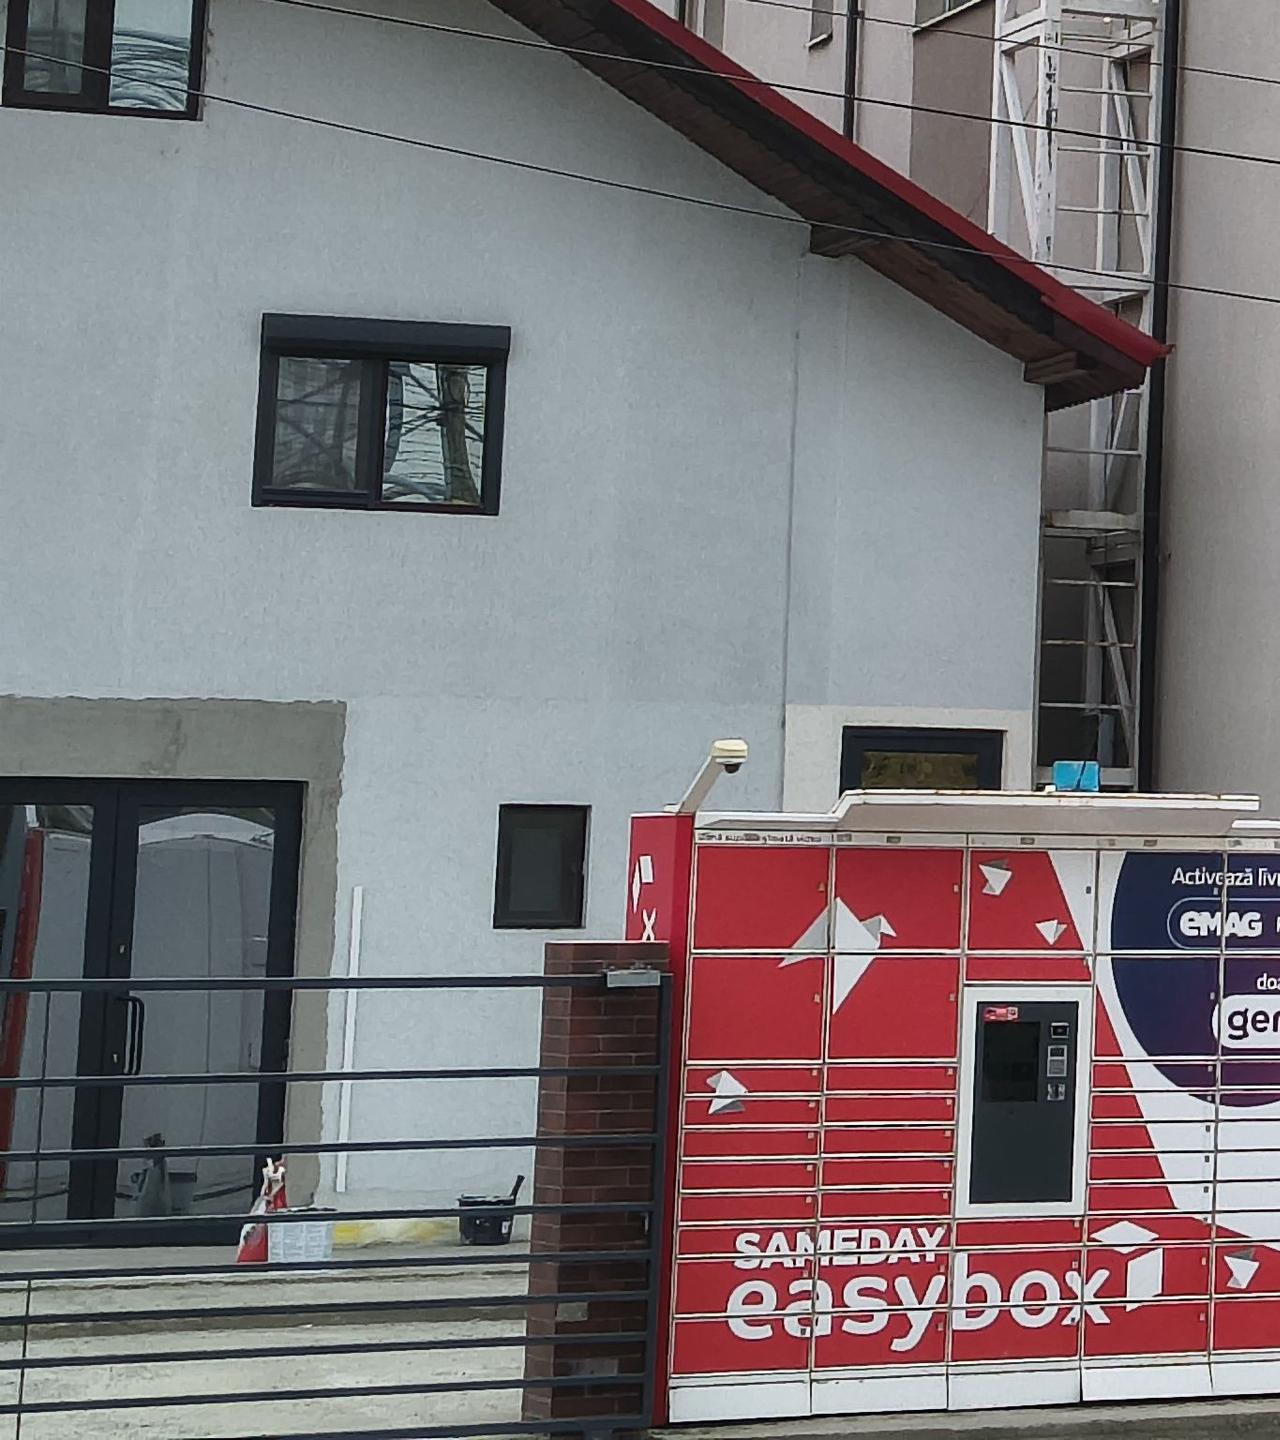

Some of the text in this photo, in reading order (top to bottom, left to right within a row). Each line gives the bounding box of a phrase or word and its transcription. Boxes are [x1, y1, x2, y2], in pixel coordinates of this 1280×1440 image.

[1172, 867, 1253, 886] Activează
[1180, 911, 1262, 938] eMAG
[735, 1227, 946, 1269] SAMEDAY
[726, 1253, 1111, 1352] easybox
